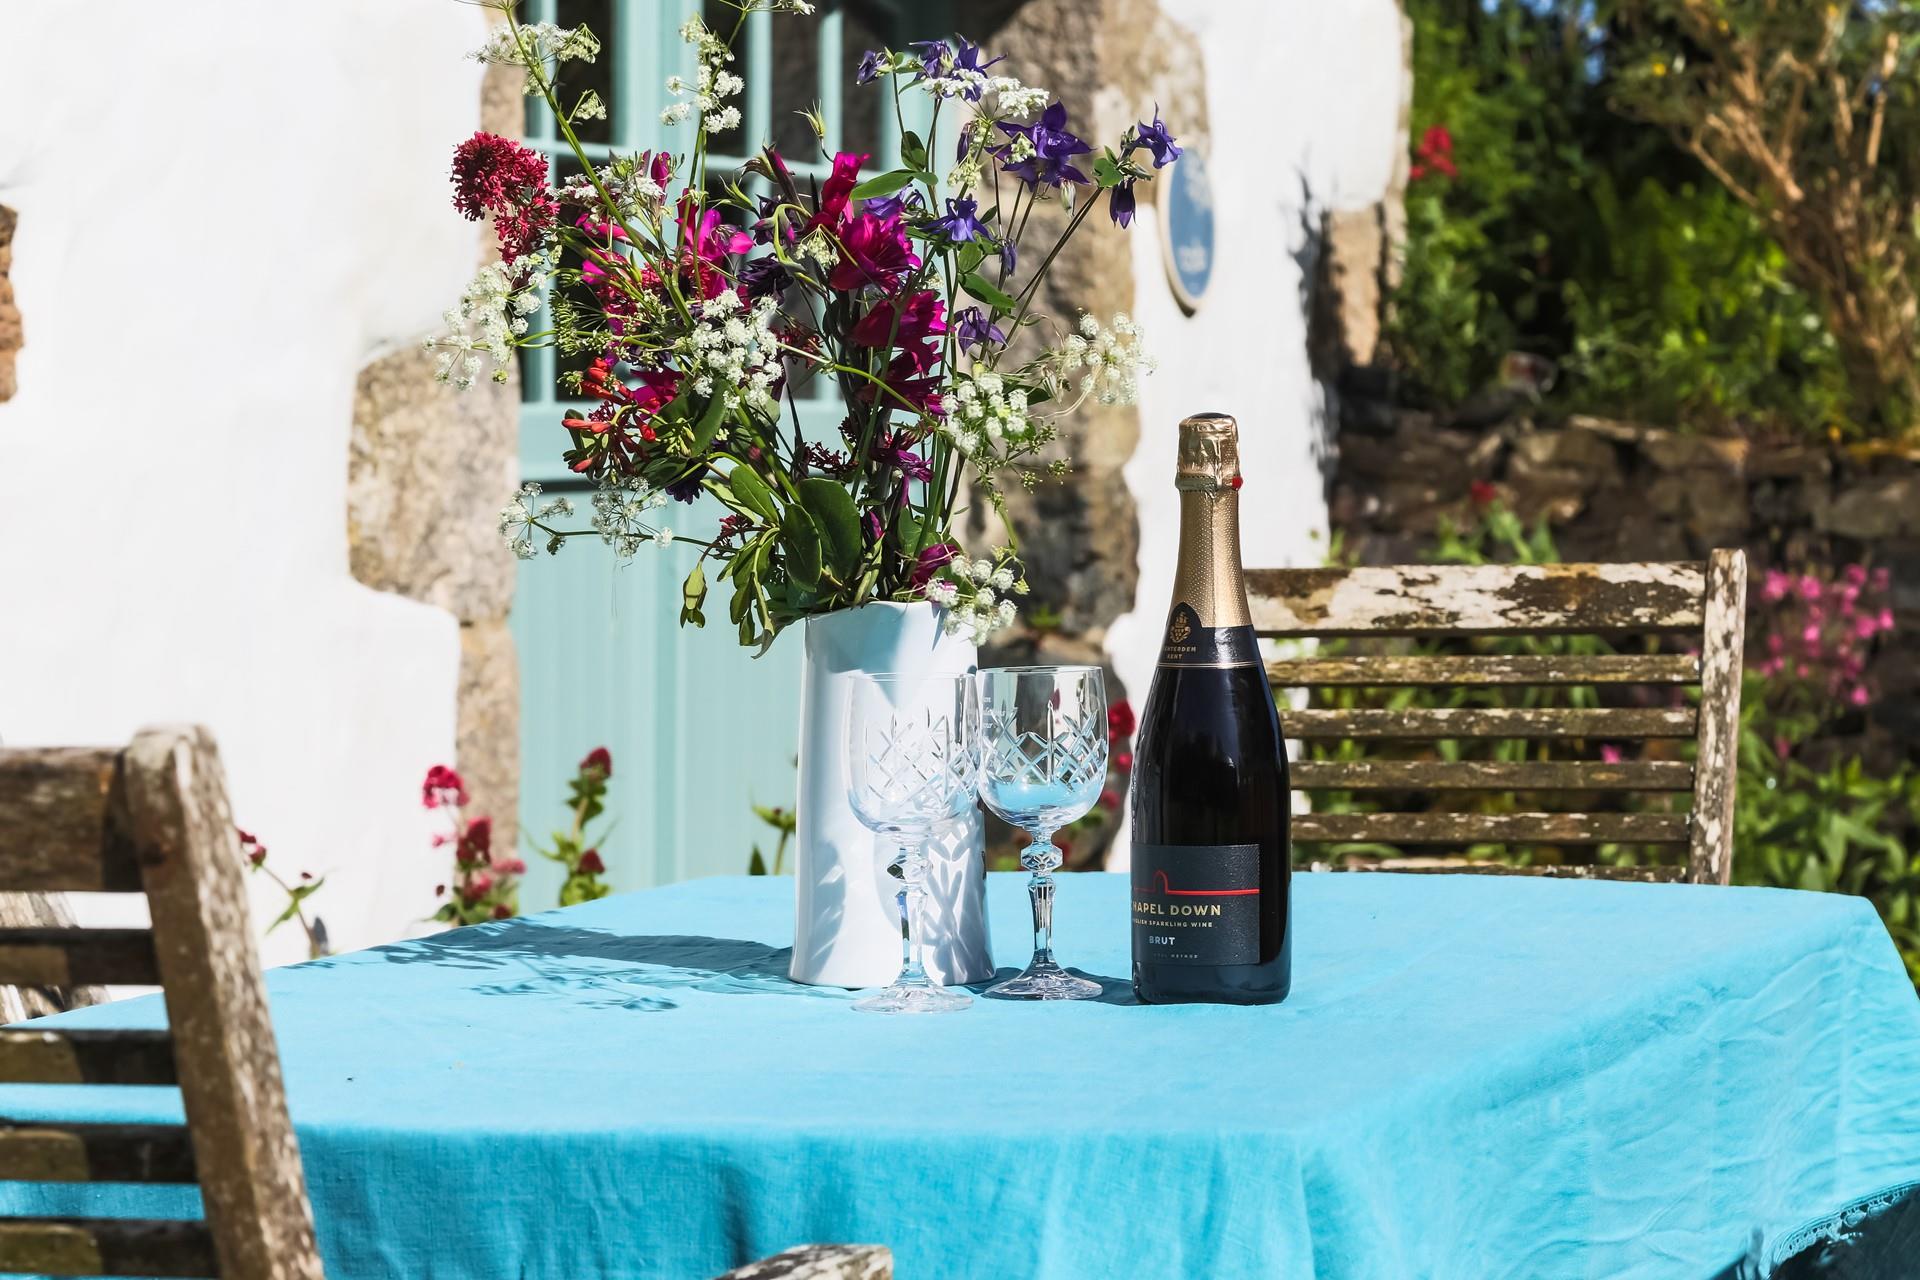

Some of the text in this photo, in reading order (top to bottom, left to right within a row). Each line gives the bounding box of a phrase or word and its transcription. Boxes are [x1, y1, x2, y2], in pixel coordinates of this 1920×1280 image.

[1132, 901, 1221, 916] HAPEL DOWN
[1149, 920, 1188, 928] SPARKLING
[1149, 935, 1176, 946] BRUT
